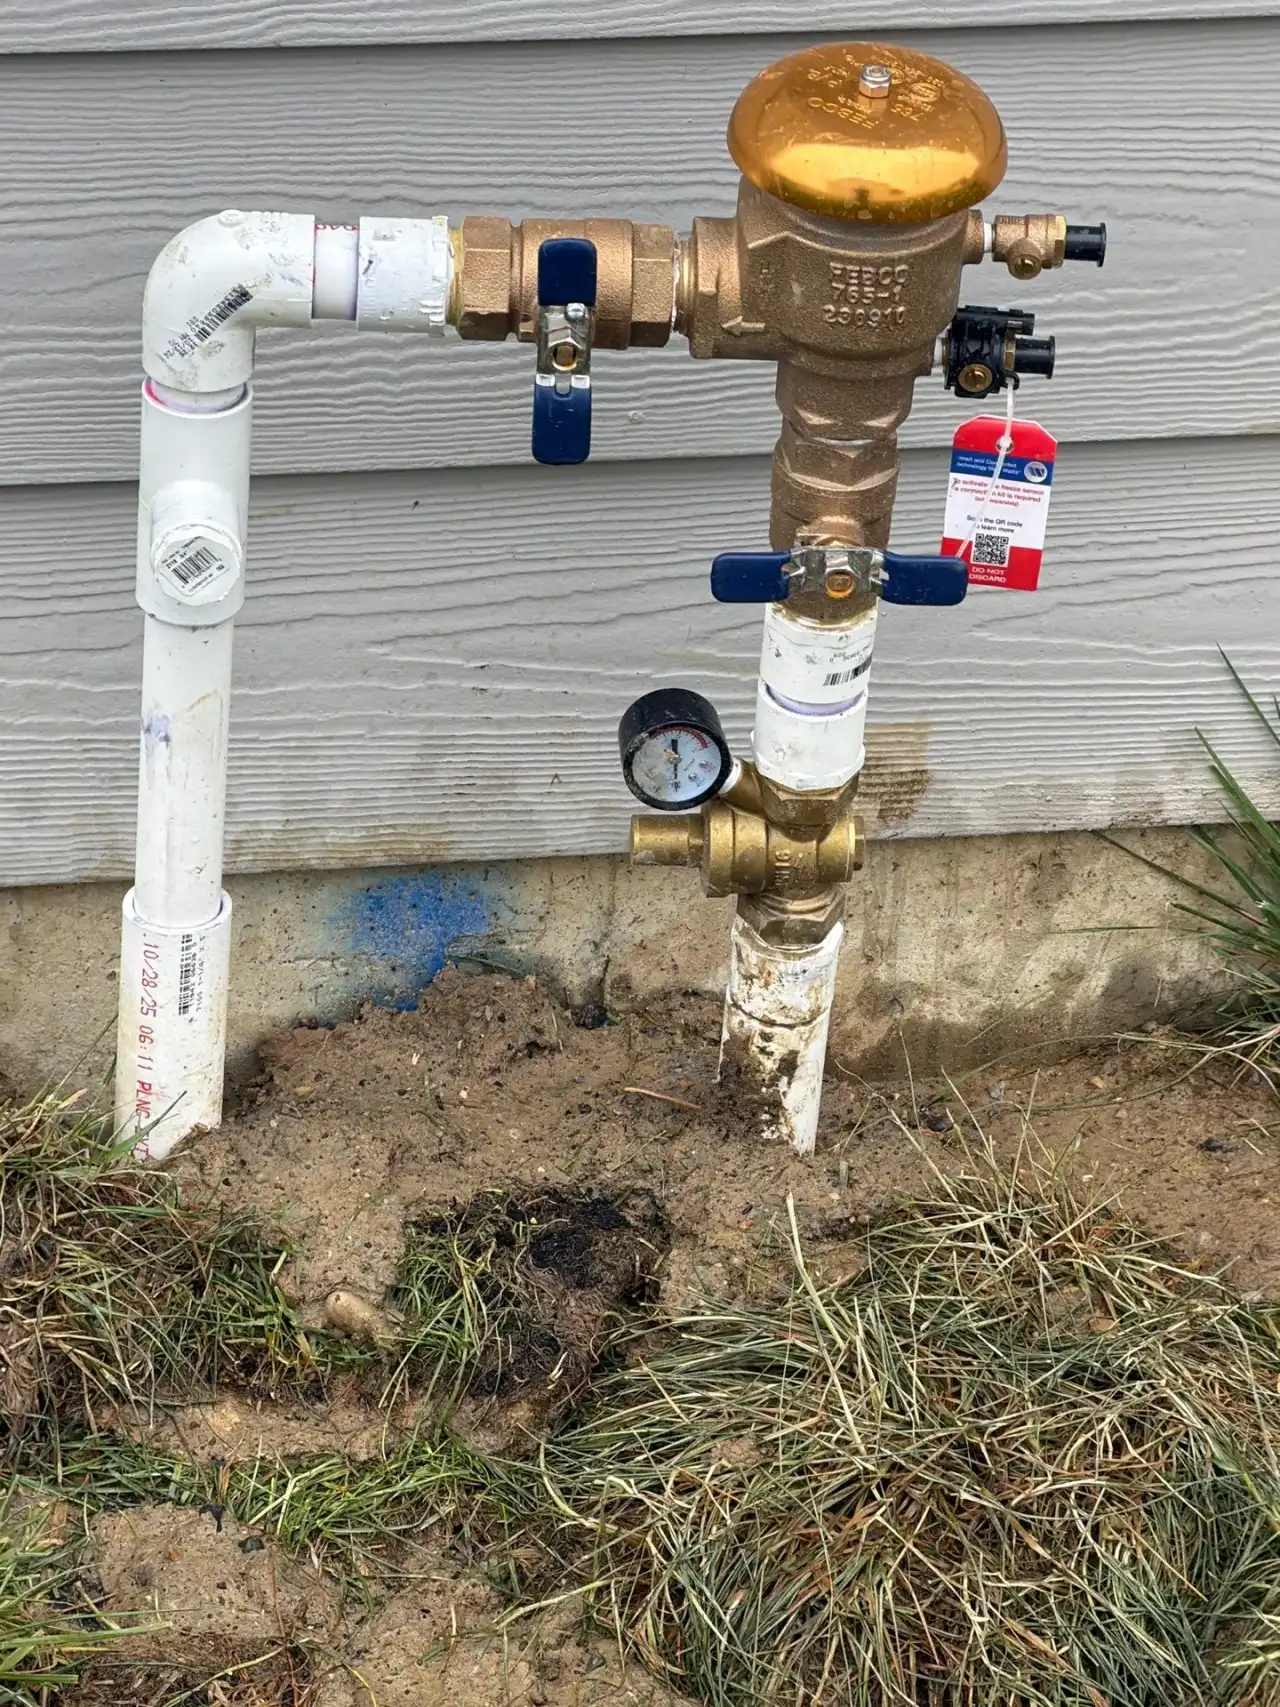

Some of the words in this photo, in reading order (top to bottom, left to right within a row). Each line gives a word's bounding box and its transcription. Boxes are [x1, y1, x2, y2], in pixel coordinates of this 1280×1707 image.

[829, 262, 909, 284] FEBCO
[831, 282, 902, 304] 765-1
[957, 455, 972, 463] mart
[956, 462, 987, 471] echnology
[962, 480, 988, 488] activate
[1001, 484, 1021, 492] freeze
[1014, 494, 1041, 503] required
[984, 516, 994, 524] the
[972, 566, 987, 574] DO
[969, 574, 1007, 583] DISCARD
[140, 942, 160, 1017] 10/28/25
[137, 1025, 154, 1070] 06:11
